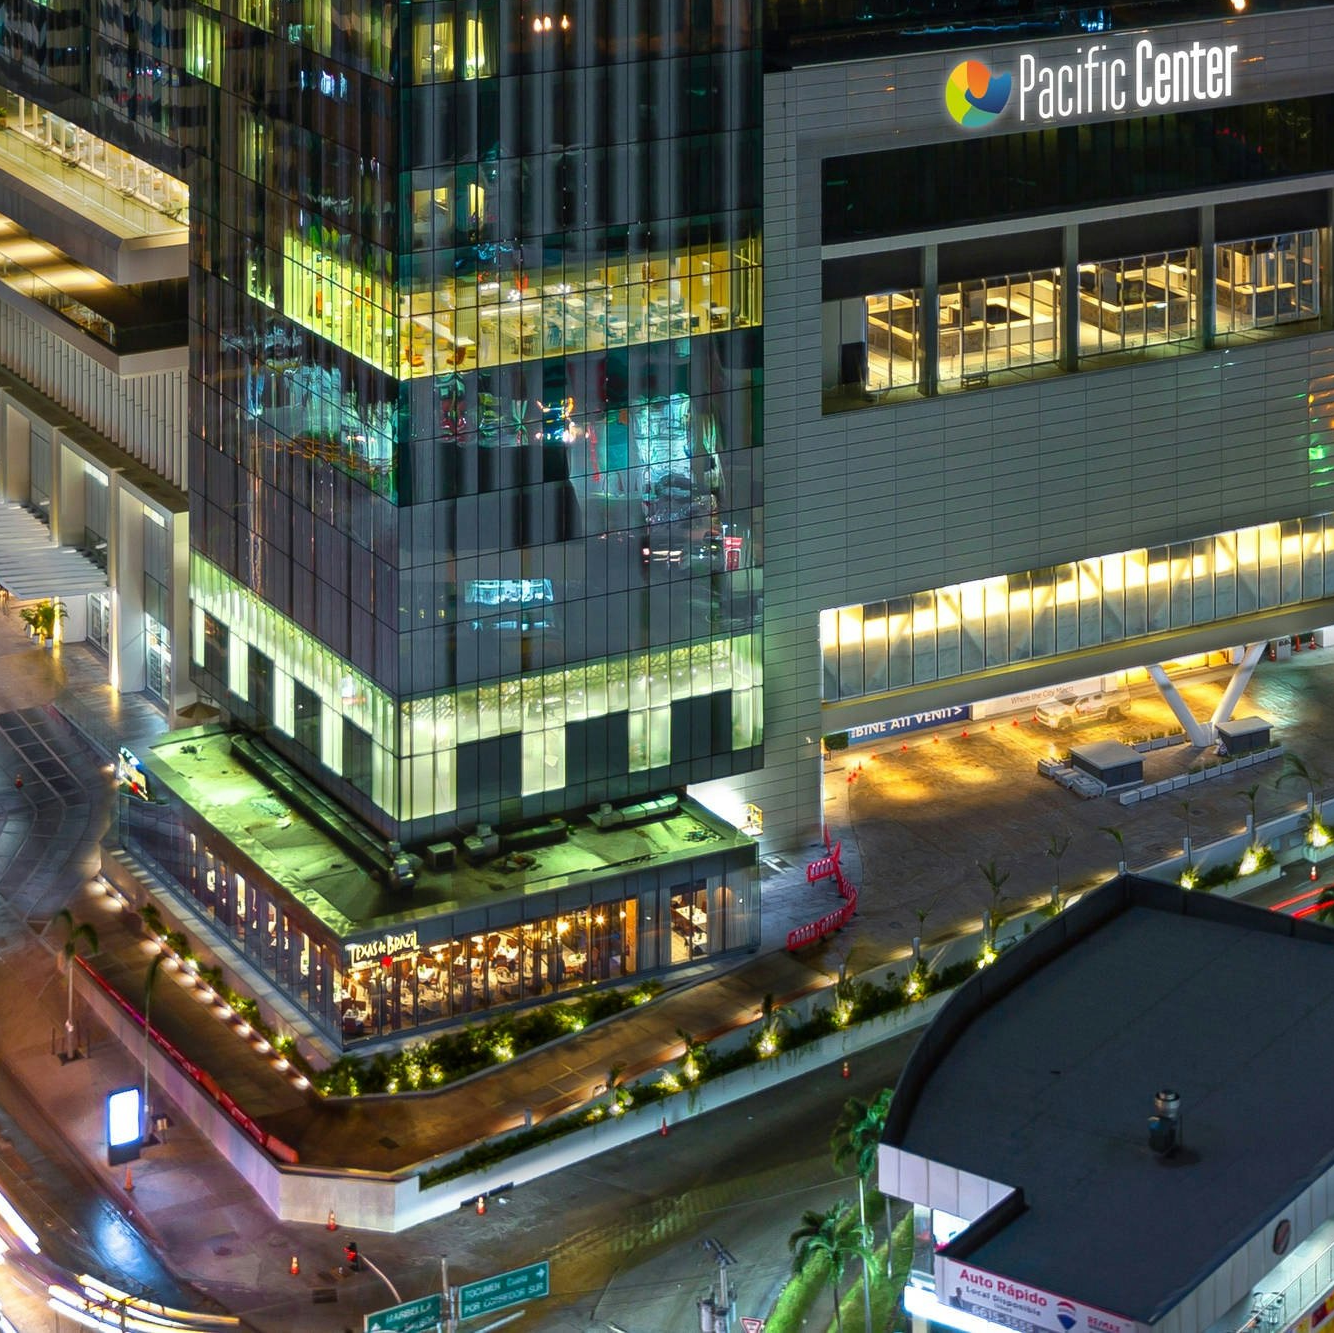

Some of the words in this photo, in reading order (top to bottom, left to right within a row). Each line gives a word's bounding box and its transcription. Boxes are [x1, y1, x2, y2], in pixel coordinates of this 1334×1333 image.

[1020, 45, 1126, 121] Pacific
[1135, 39, 1238, 107] Center
[345, 941, 378, 968] TEXAS
[960, 1268, 993, 1289] Auto
[997, 1280, 1048, 1307] Rápido
